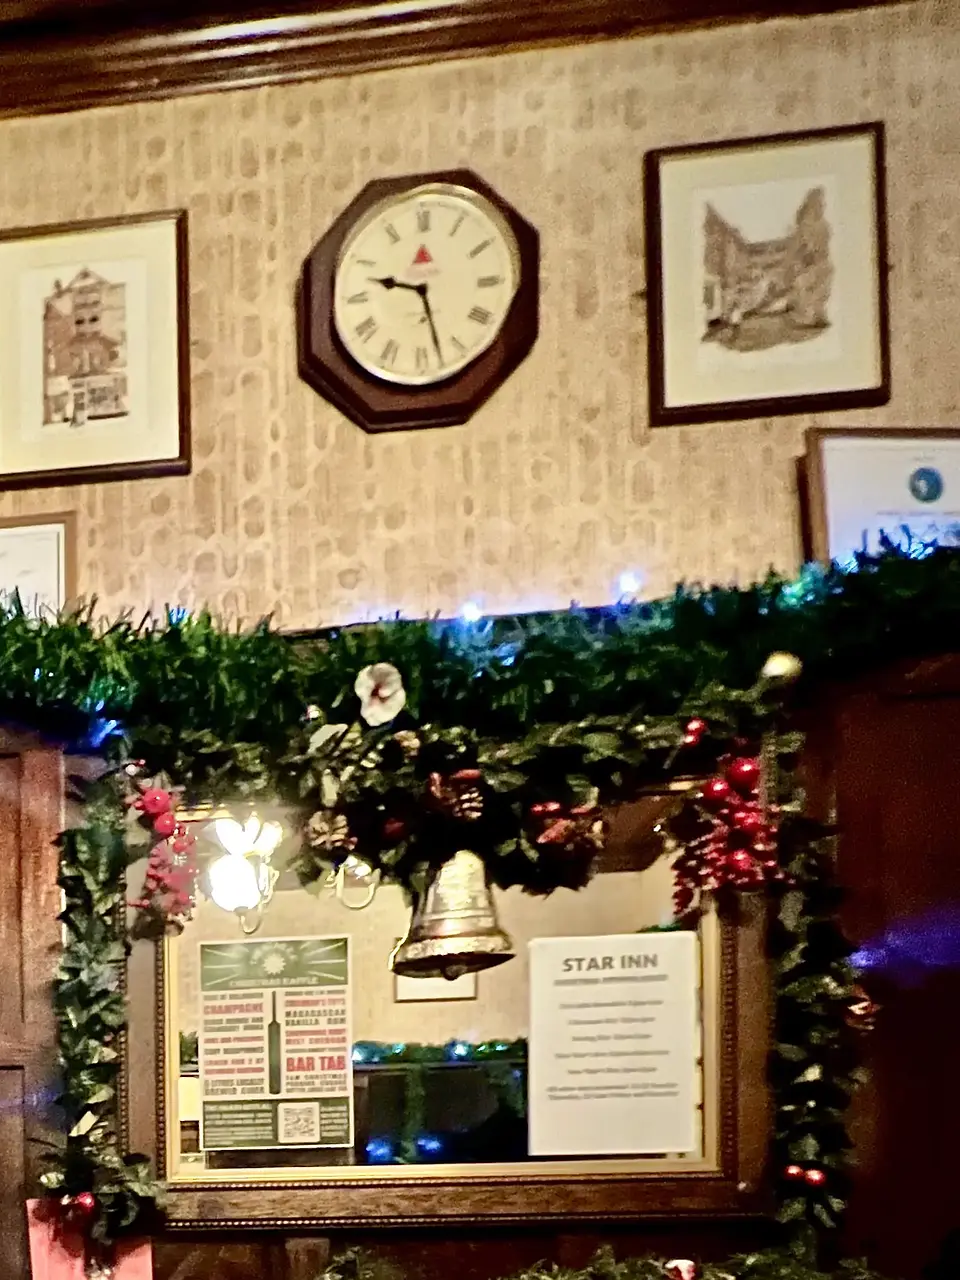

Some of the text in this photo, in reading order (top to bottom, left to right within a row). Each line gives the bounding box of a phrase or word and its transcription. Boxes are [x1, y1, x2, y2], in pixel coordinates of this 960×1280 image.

[562, 953, 658, 972] STAR INN
[286, 1055, 346, 1072] BAR TAB
